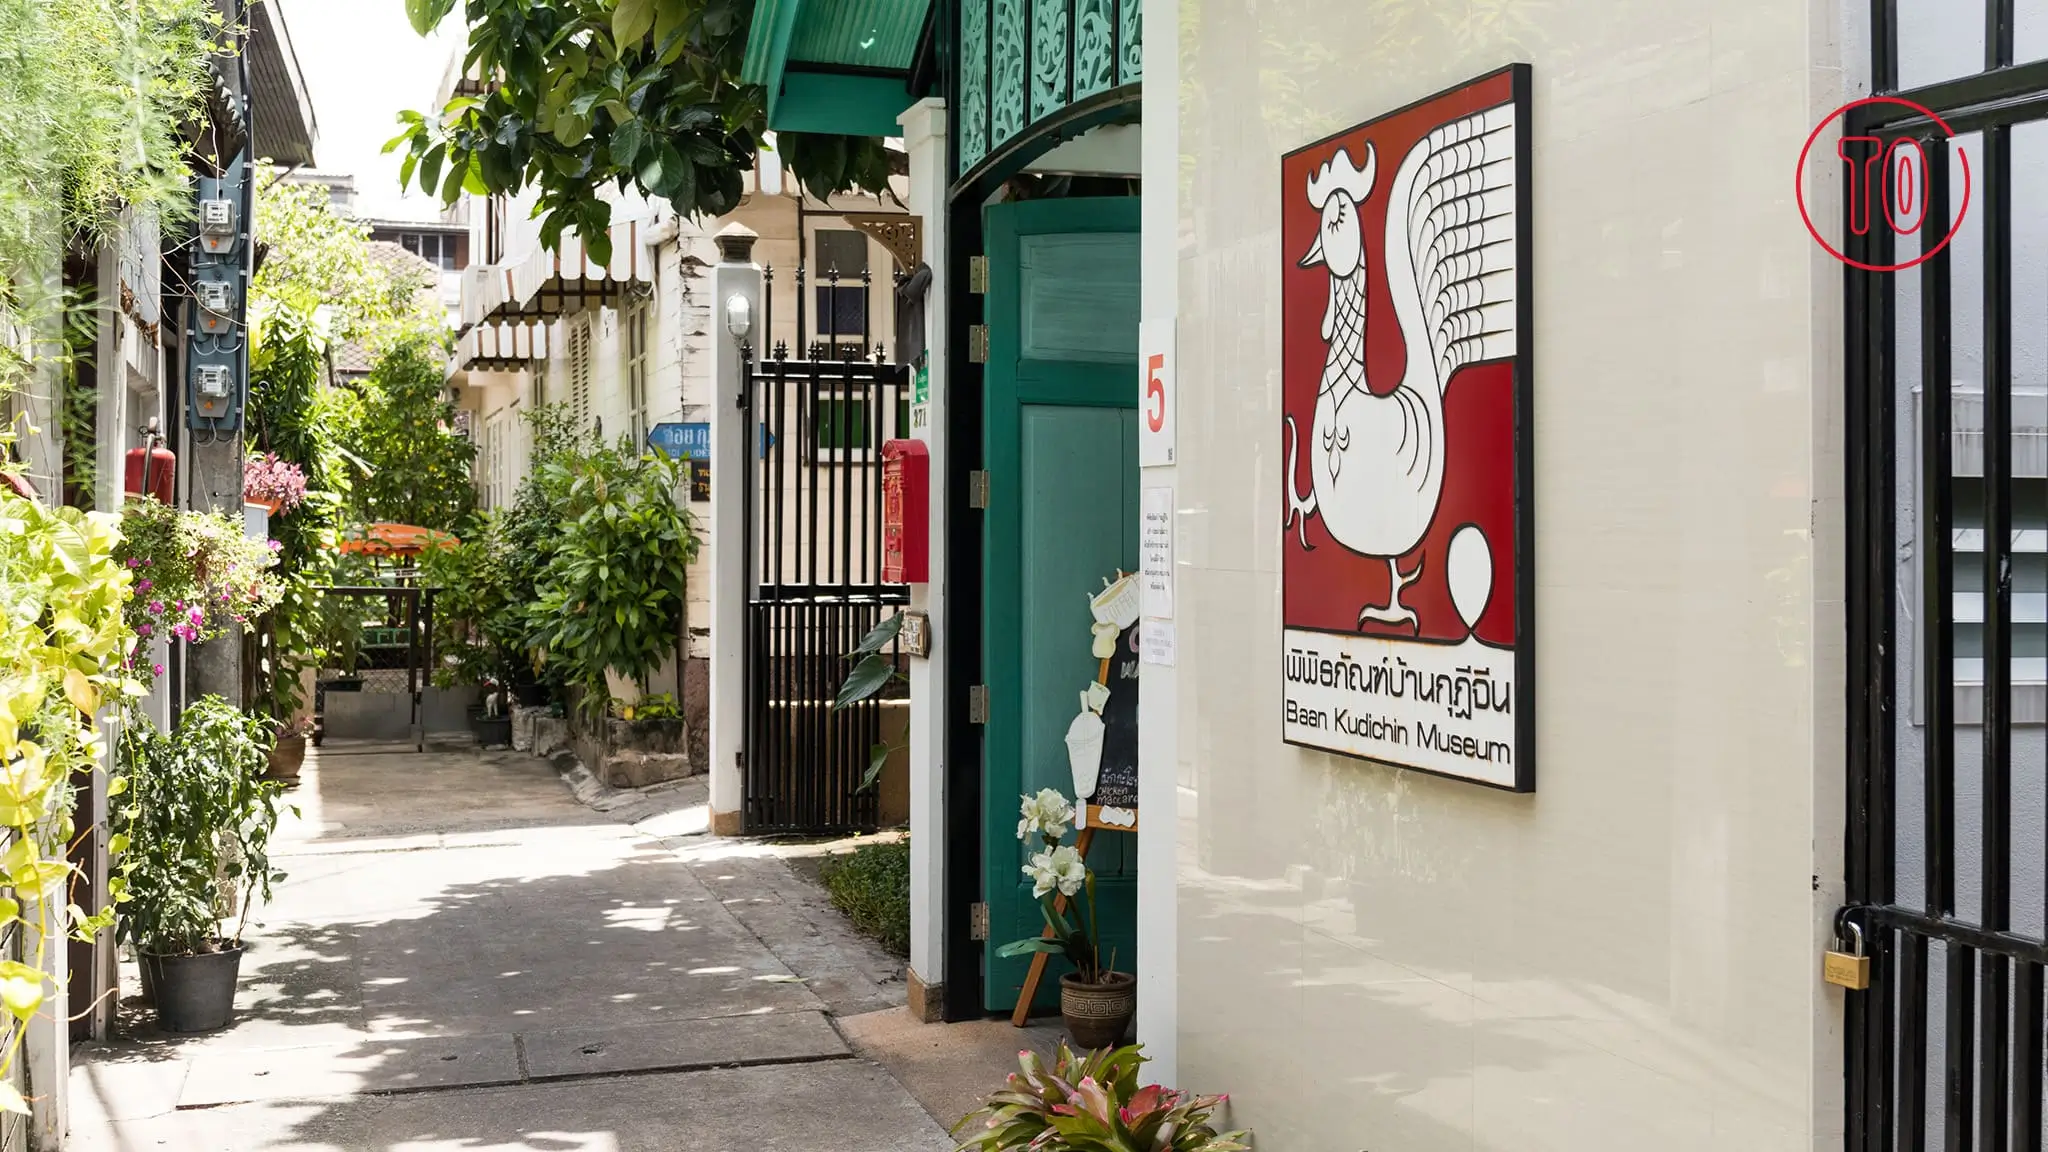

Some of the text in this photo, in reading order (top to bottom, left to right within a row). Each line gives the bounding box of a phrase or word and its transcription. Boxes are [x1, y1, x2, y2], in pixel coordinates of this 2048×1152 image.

[1147, 353, 1165, 433] 5
[1286, 699, 1511, 764] Baan Kudichin Museum
